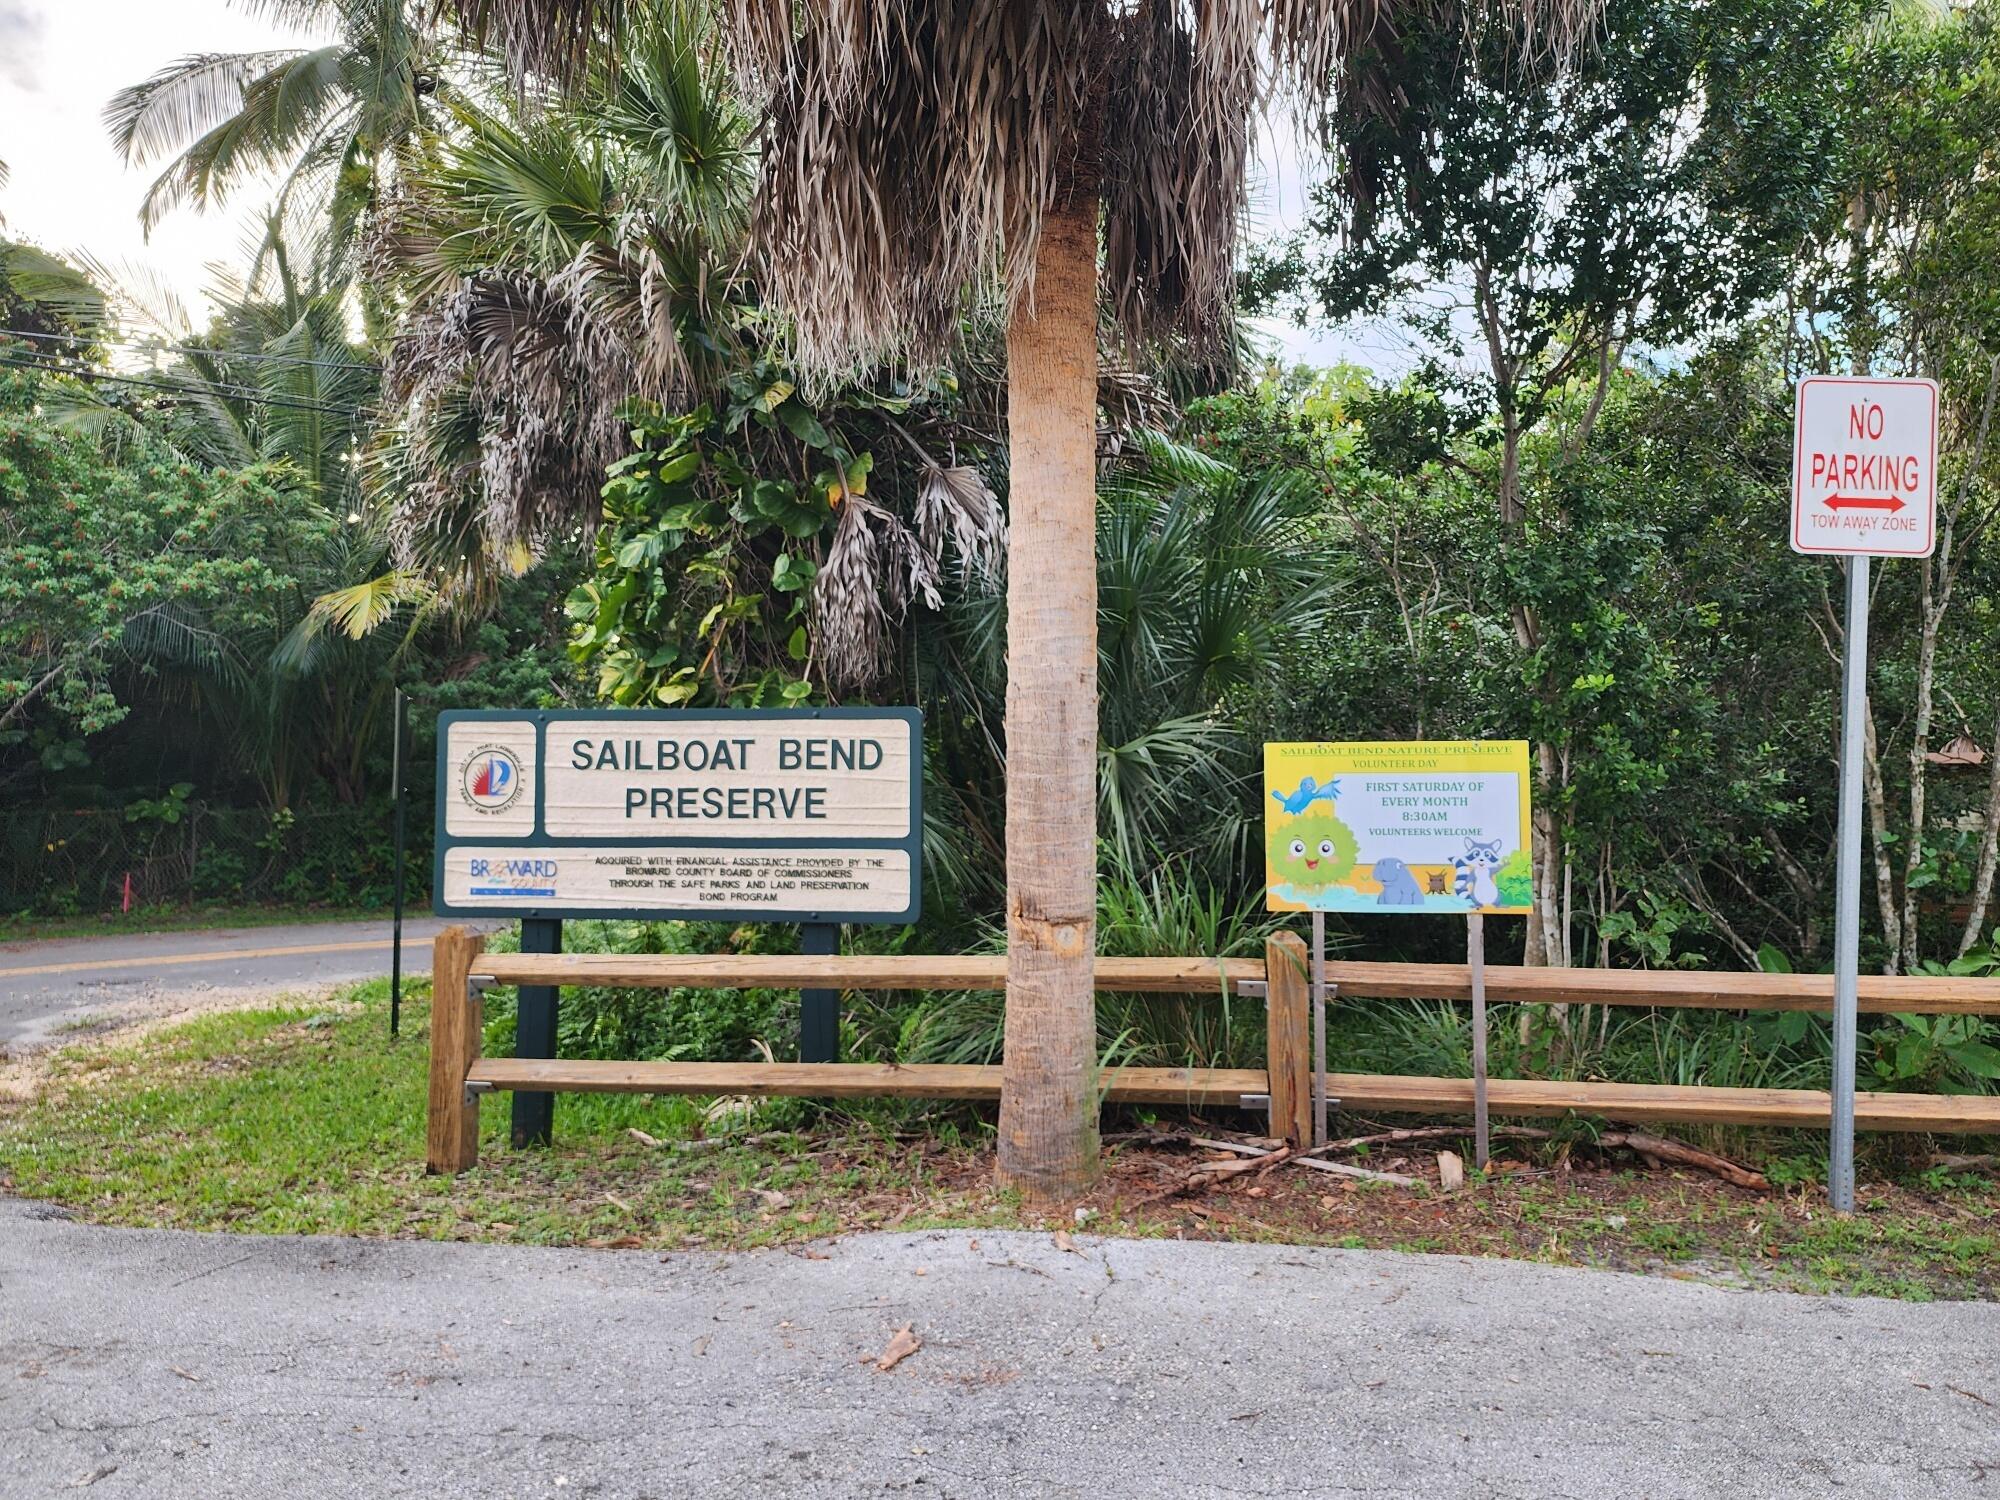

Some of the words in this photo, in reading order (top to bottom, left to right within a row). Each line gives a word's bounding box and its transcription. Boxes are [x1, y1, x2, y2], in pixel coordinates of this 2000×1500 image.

[1850, 404, 1884, 440] NO
[1811, 453, 1919, 492] PARKING
[1811, 514, 1840, 529] TOW
[1843, 515, 1879, 531] AWAY
[1882, 517, 1917, 532] ZONE
[571, 739, 756, 771] SAILBOAT
[779, 739, 884, 770] BEND
[1281, 747, 1342, 755] SAILBOAT
[1348, 747, 1384, 755] BEND
[1388, 746, 1441, 754] NATURE
[1444, 745, 1512, 754] PRESERVE
[1352, 759, 1416, 768] VOLUNTEER
[1418, 759, 1440, 768] DAY
[1366, 782, 1400, 792] FIRST
[1402, 782, 1465, 792] SATURDAY
[1468, 782, 1485, 791] OF
[625, 787, 828, 819] PRESERVE
[1381, 797, 1419, 806] EVERY
[1422, 797, 1468, 806] MONTH
[1402, 811, 1448, 821] 8:30AM
[1369, 828, 1431, 836] VOLUNTEERS
[1433, 827, 1483, 836] WELCOME
[595, 857, 642, 865] ACQUIRED
[648, 857, 672, 865] WITH
[676, 857, 727, 866] FINANCIAL
[732, 857, 792, 867] ASSISTANCE
[796, 858, 844, 867] PROVIDED
[848, 859, 860, 867] BY
[866, 859, 885, 867] THE
[625, 867, 671, 875] BROWARD
[675, 868, 715, 876] COUNTY
[720, 868, 752, 877] BOARD
[757, 869, 770, 877] OF
[774, 869, 853, 878] COMMISSIONERS
[608, 879, 653, 888] THROUGH
[658, 879, 676, 888] THE
[681, 880, 705, 888] SAFE
[710, 880, 740, 889] PARKS
[746, 881, 765, 889] AND
[770, 881, 796, 889] LAND
[800, 881, 869, 890] PRESERVATION
[699, 893, 725, 901] BOND
[730, 892, 778, 902] PROGRAM
